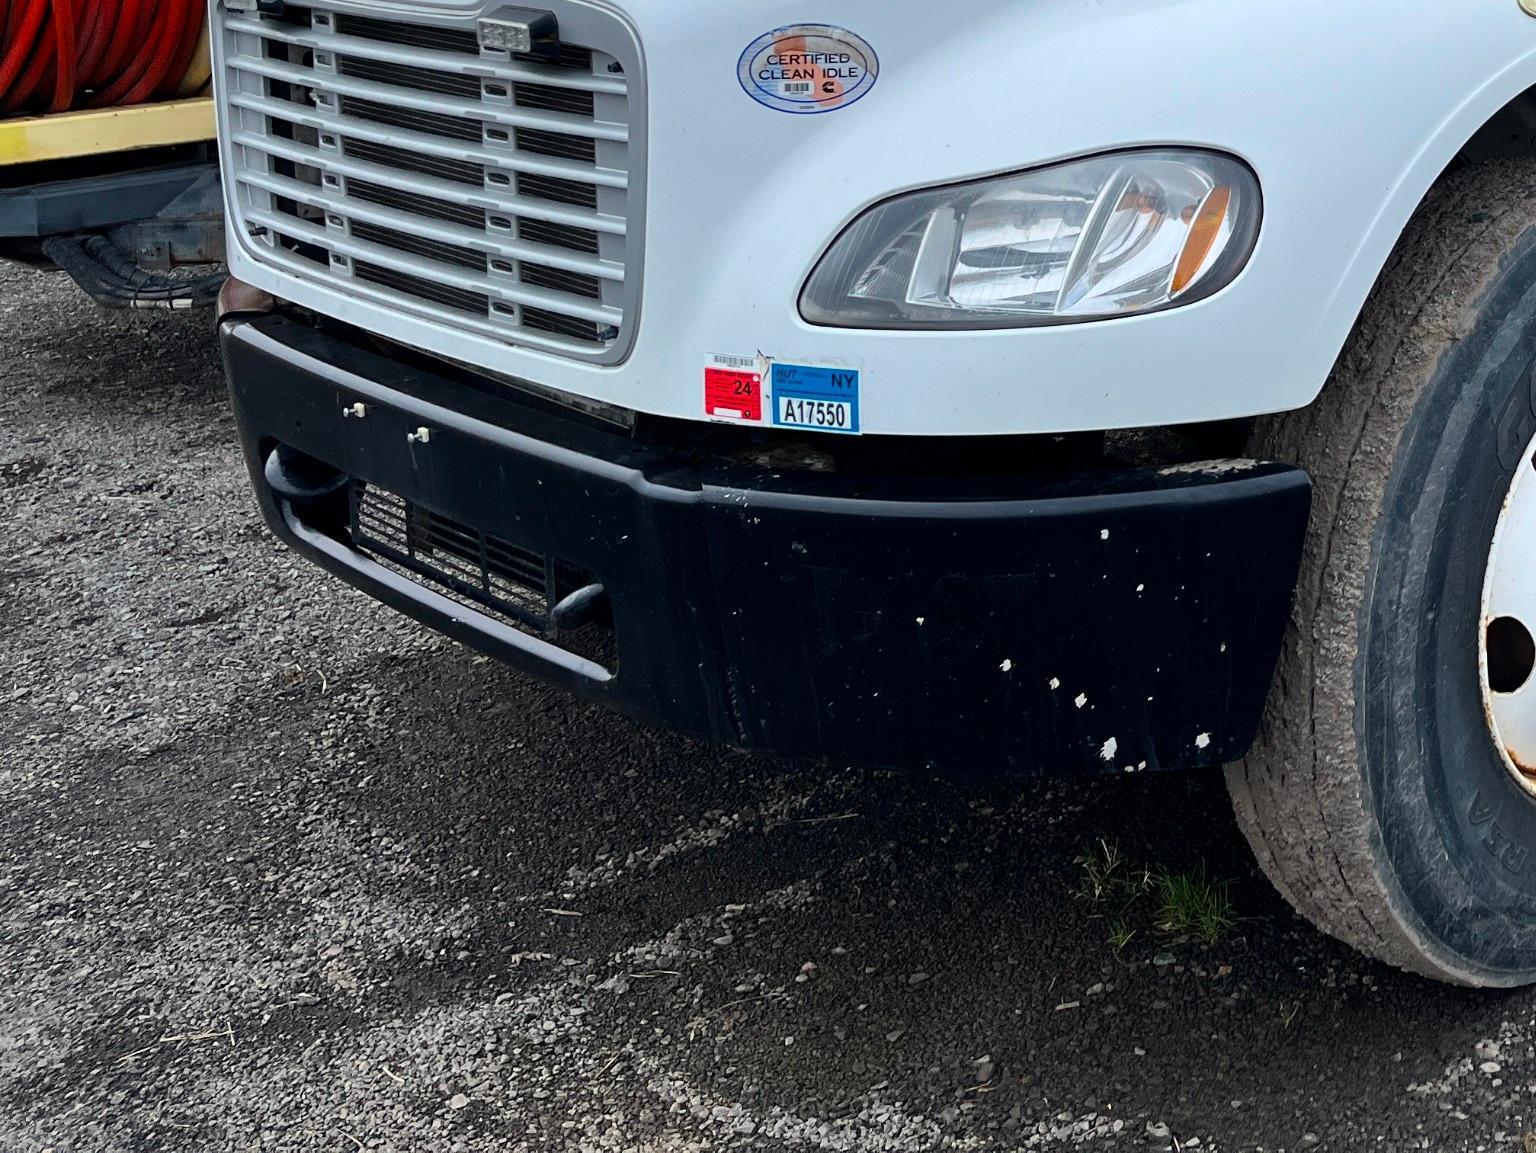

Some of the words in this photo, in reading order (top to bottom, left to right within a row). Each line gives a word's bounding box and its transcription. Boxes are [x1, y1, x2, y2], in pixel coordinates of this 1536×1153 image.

[766, 52, 851, 66] CERTIFIED
[758, 68, 815, 81] CLEAN
[822, 67, 859, 79] IDLE
[733, 379, 753, 396] 24
[830, 373, 856, 389] NY
[784, 399, 846, 427] A17550
